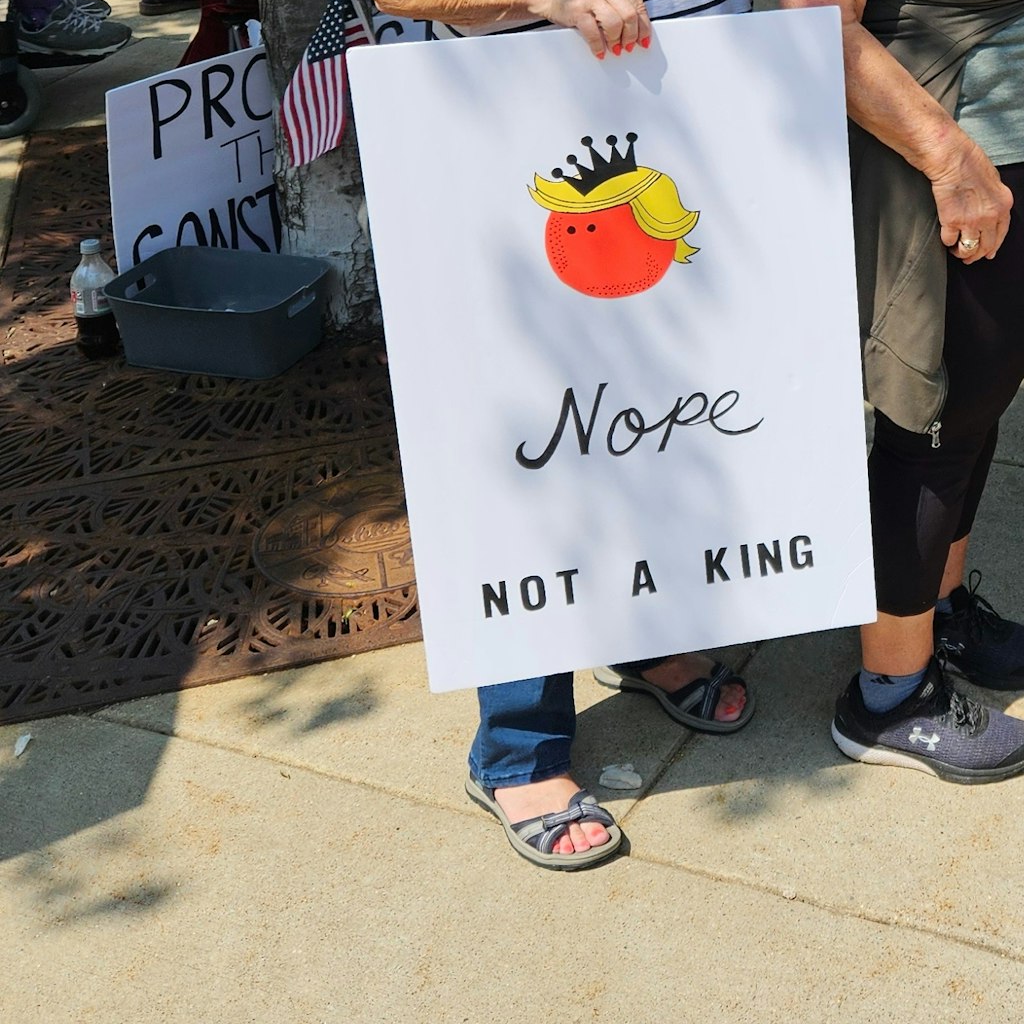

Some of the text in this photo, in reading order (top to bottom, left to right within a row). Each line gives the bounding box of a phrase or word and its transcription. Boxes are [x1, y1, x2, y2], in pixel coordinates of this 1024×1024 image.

[515, 382, 765, 470] Nope
[481, 535, 814, 618] NOT A KING
